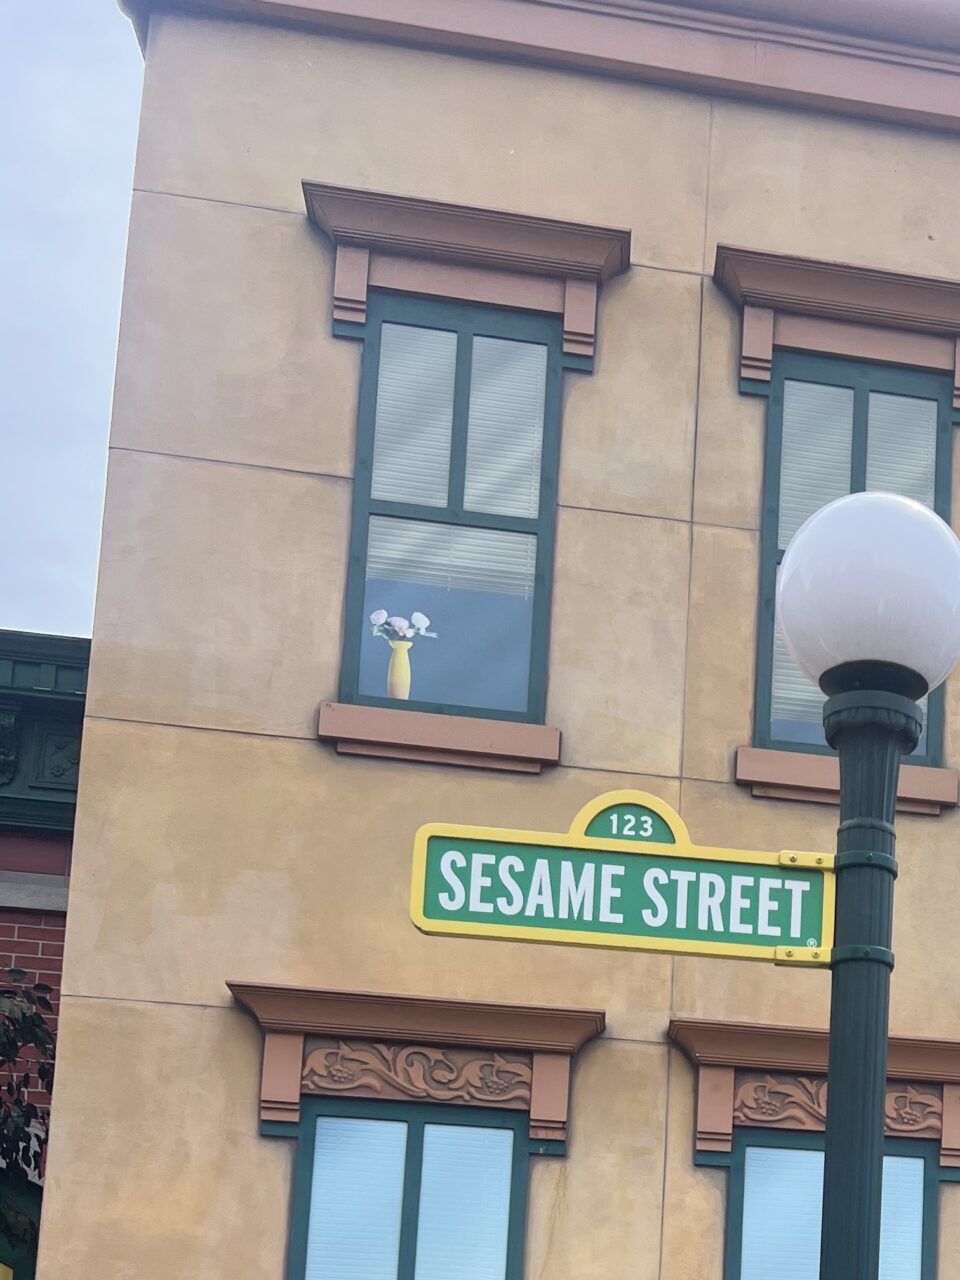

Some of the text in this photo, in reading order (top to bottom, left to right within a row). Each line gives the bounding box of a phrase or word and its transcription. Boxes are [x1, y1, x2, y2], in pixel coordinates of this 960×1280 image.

[609, 814, 654, 838] 123
[438, 850, 811, 938] SESAME STREET
